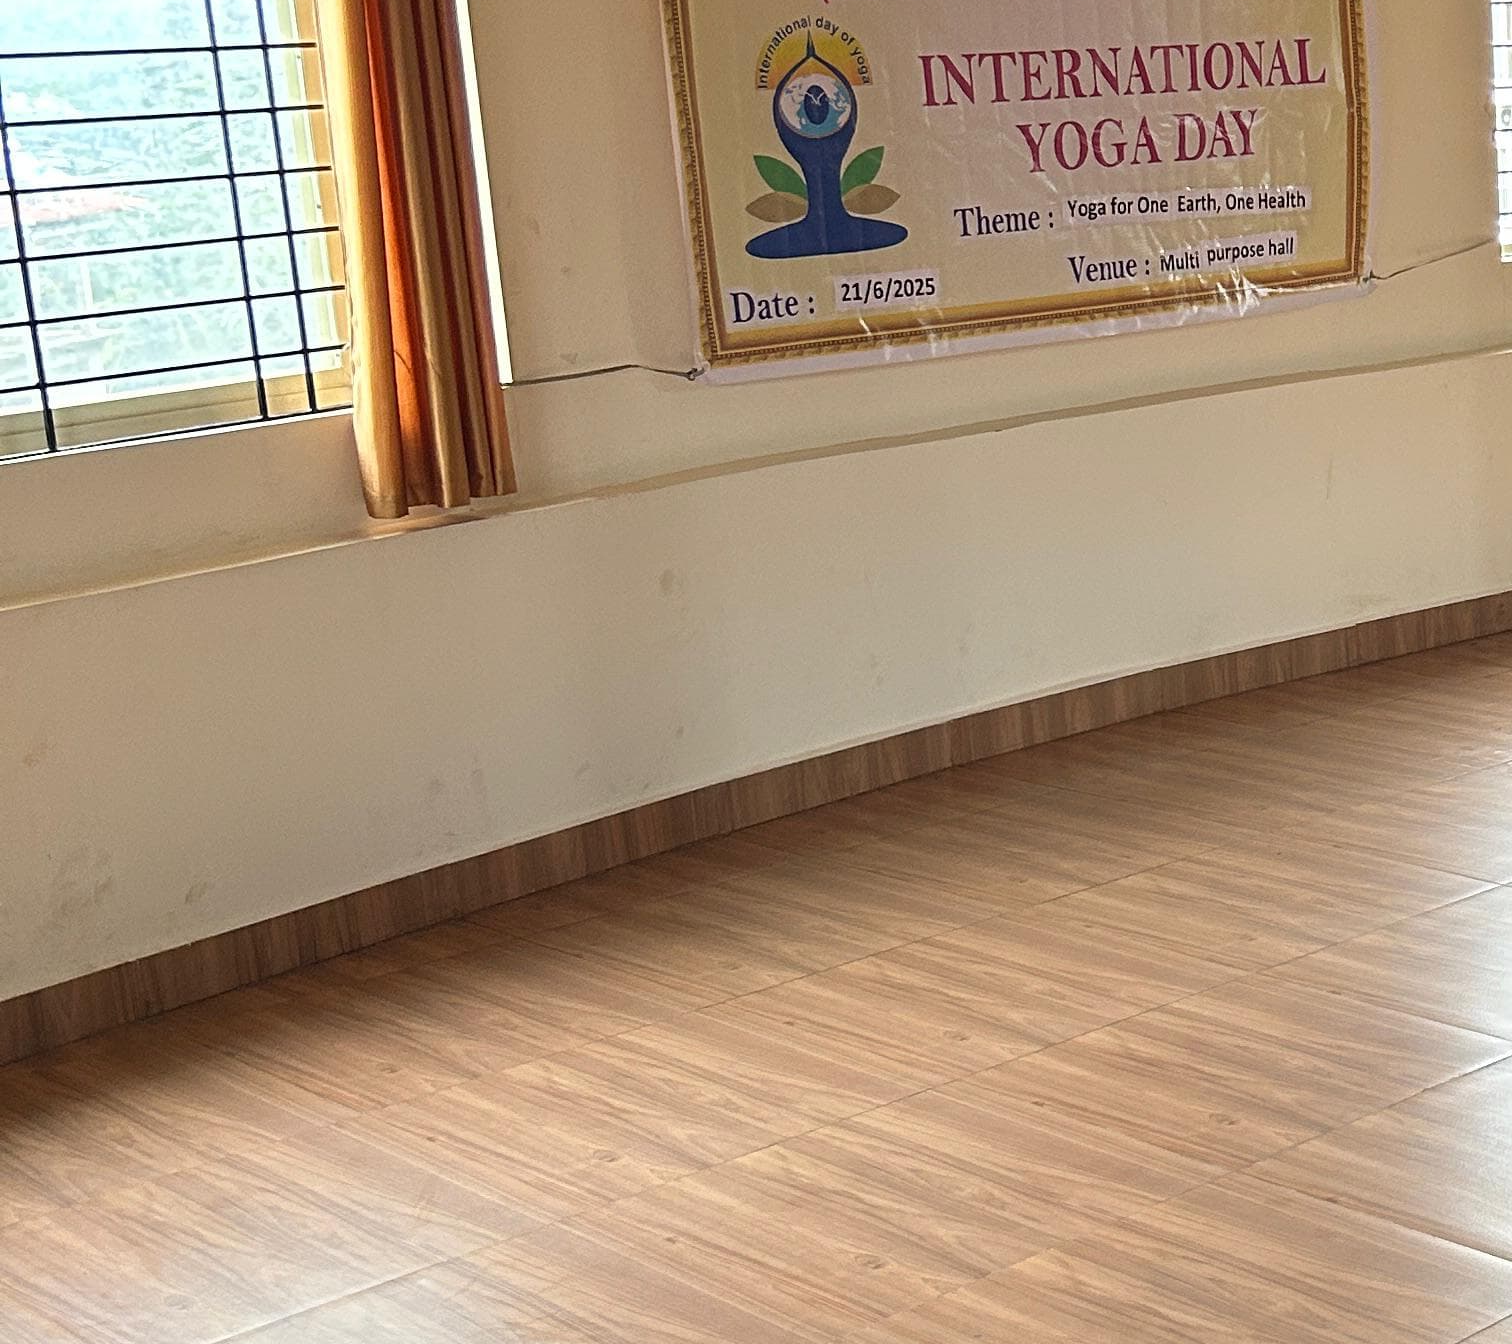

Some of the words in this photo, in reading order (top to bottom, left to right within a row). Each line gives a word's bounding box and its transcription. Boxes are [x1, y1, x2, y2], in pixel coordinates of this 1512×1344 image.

[757, 15, 811, 89] International
[815, 17, 840, 36] day
[841, 31, 856, 46] of
[850, 47, 871, 84] yoga
[917, 38, 1327, 107] INTERNATIONAL
[1015, 115, 1162, 173] YOGA
[1174, 108, 1258, 162] DAY
[1068, 200, 1106, 220] Yoga
[1111, 197, 1133, 215] for
[1137, 196, 1168, 214] One
[1177, 193, 1221, 214] Earth,
[1225, 193, 1254, 210] One
[1258, 190, 1306, 209] Health
[1160, 251, 1200, 272] Multi
[1207, 243, 1264, 265] purpose
[1268, 237, 1294, 256] hall
[841, 277, 935, 304] 21/6/2025
